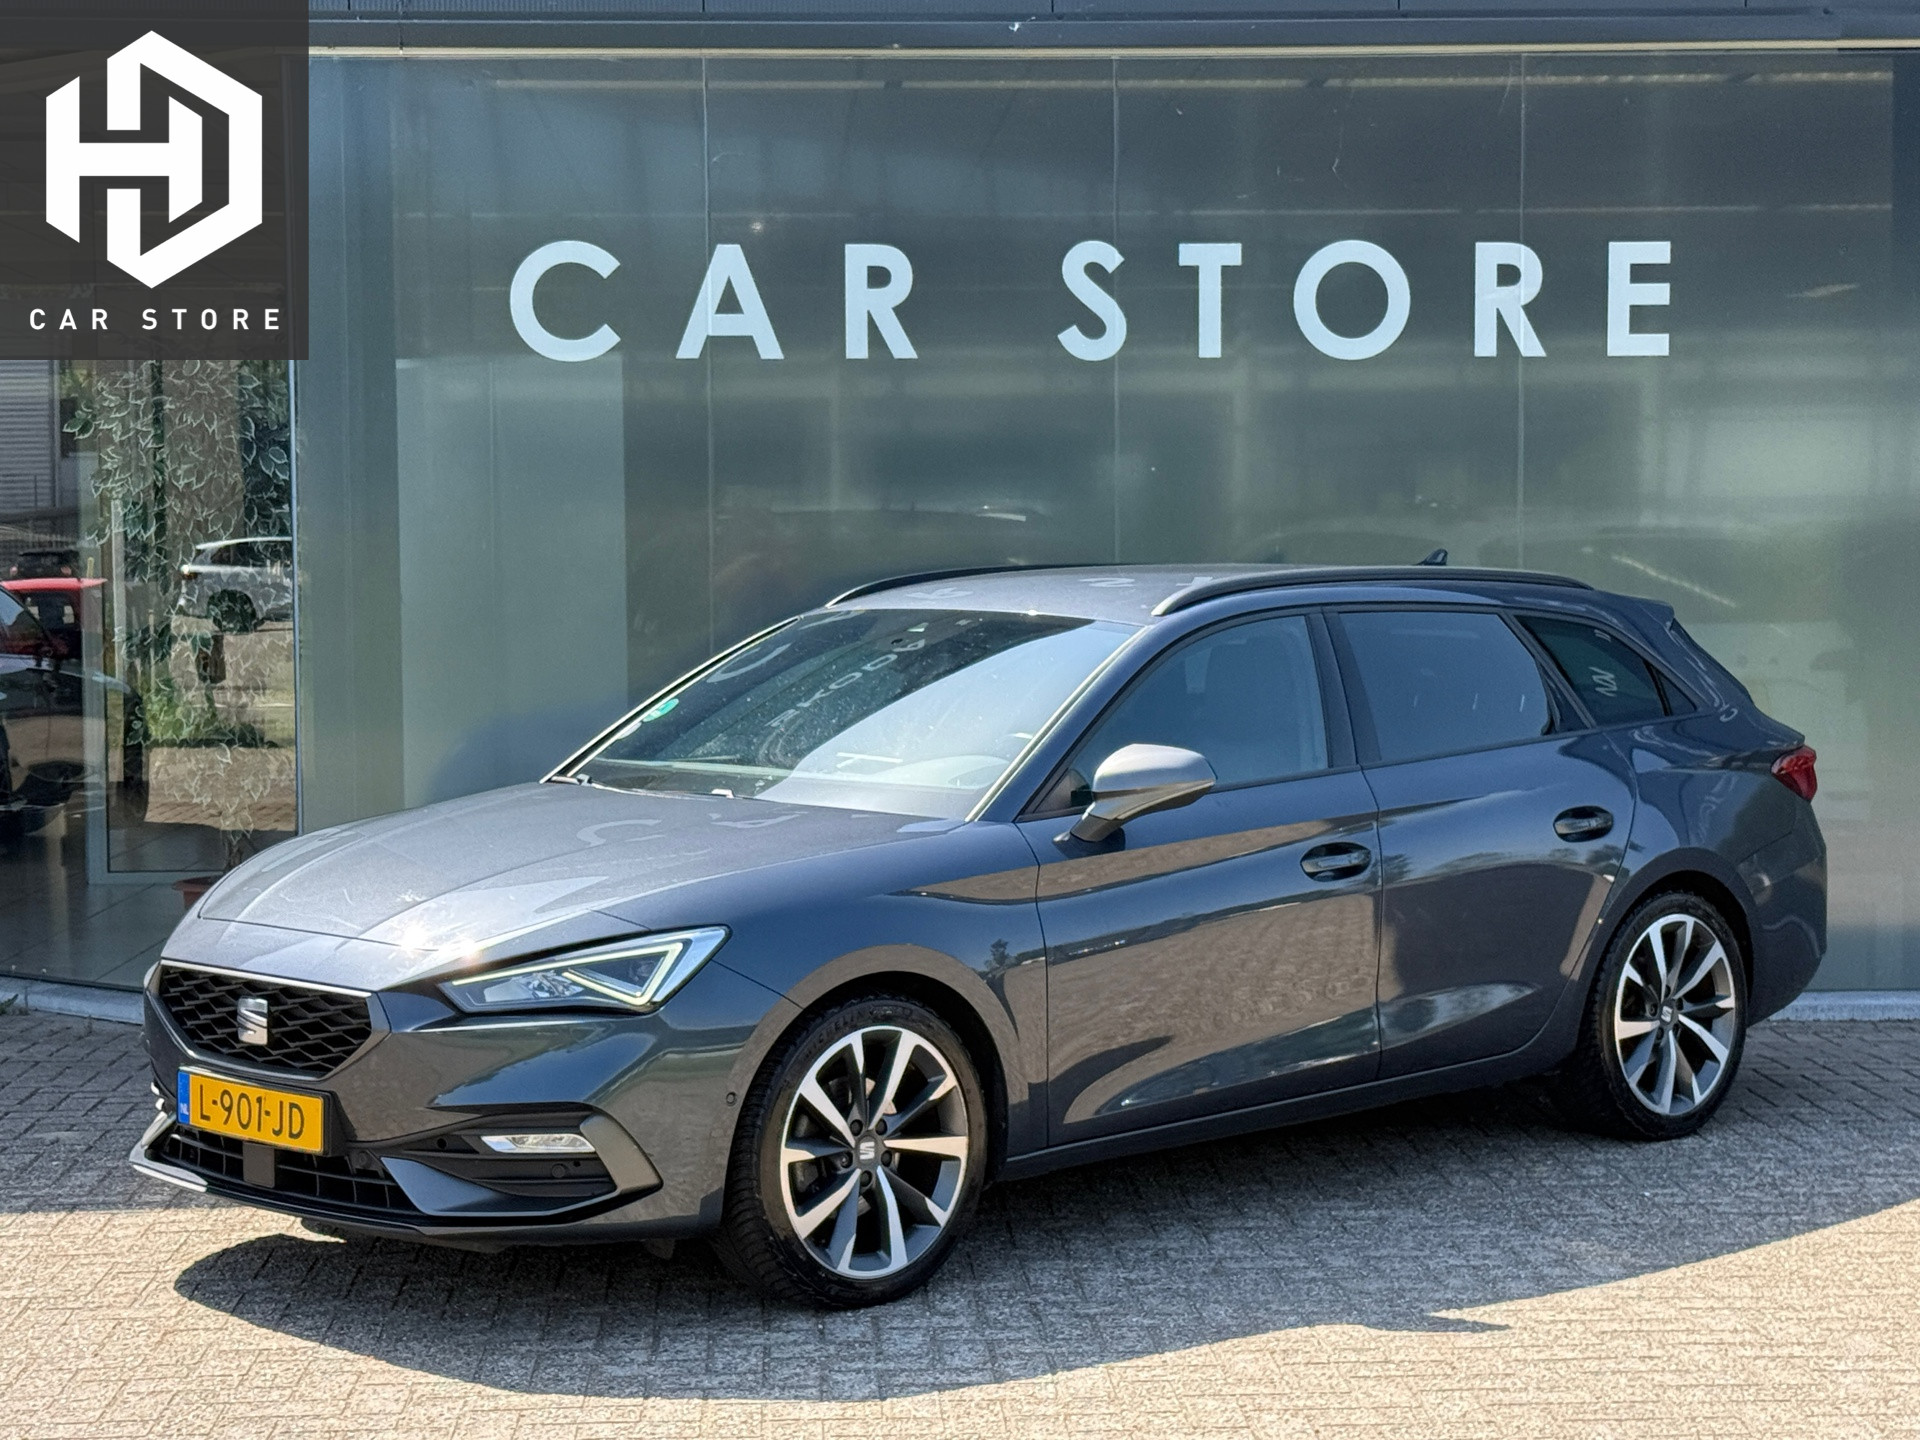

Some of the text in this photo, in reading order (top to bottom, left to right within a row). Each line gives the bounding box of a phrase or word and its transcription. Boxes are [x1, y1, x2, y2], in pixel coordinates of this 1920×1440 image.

[509, 239, 1672, 362] CAR STORE
[199, 1084, 305, 1139] L-901-JD
